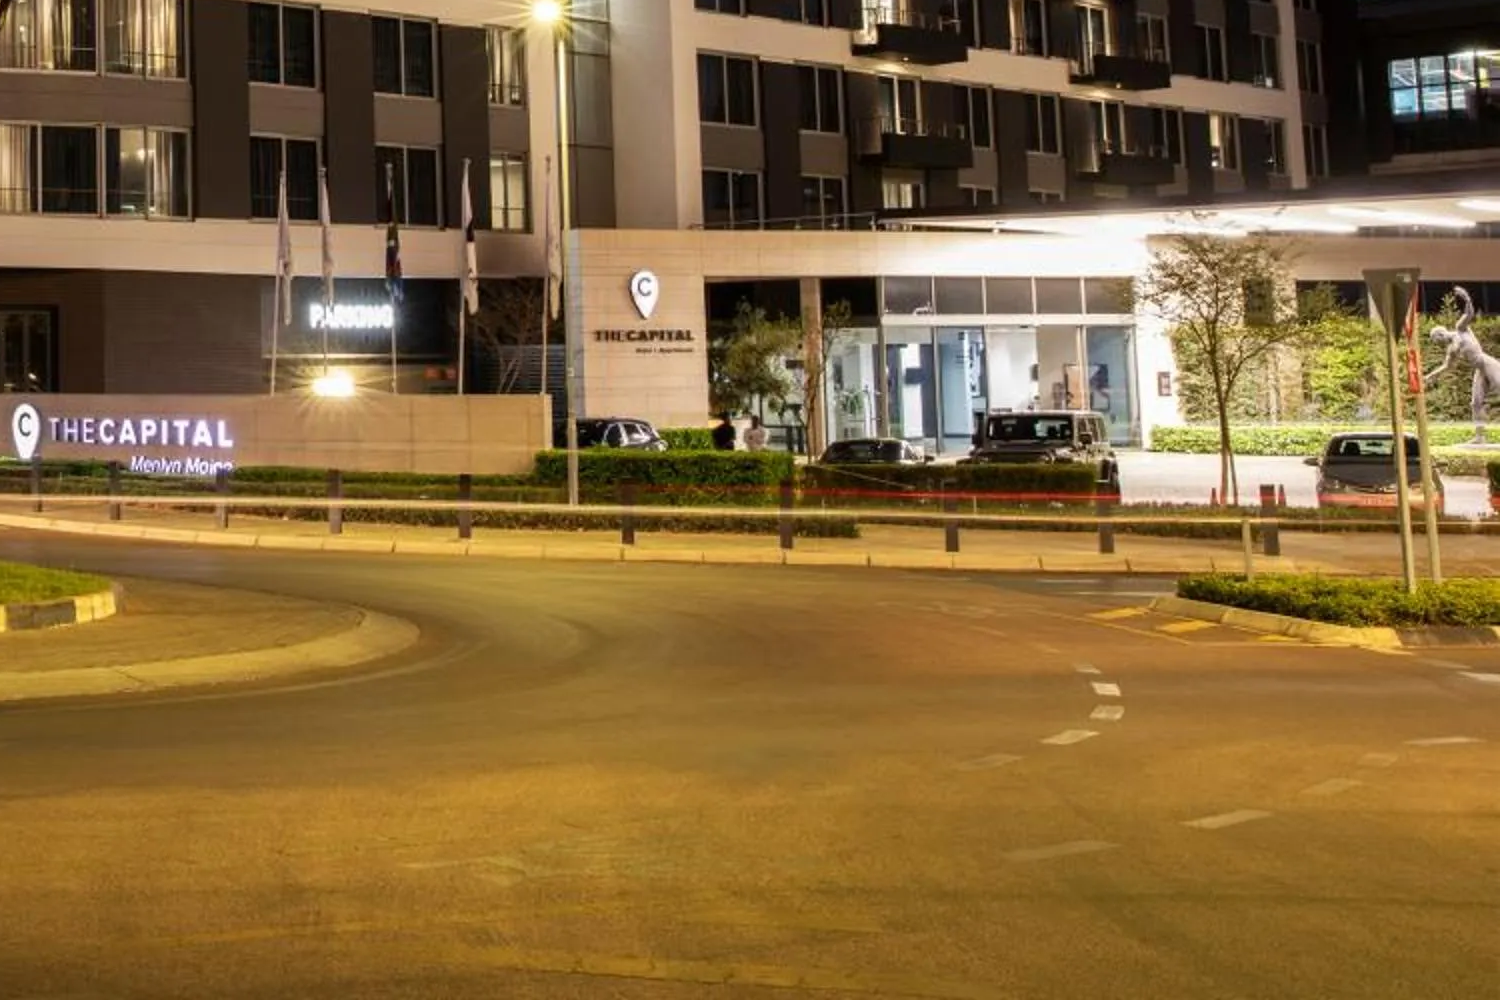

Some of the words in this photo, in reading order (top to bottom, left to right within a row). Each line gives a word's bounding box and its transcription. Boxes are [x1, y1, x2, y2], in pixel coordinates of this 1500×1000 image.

[637, 277, 652, 297] C
[17, 413, 32, 437] C
[130, 455, 182, 475] Menlyn
